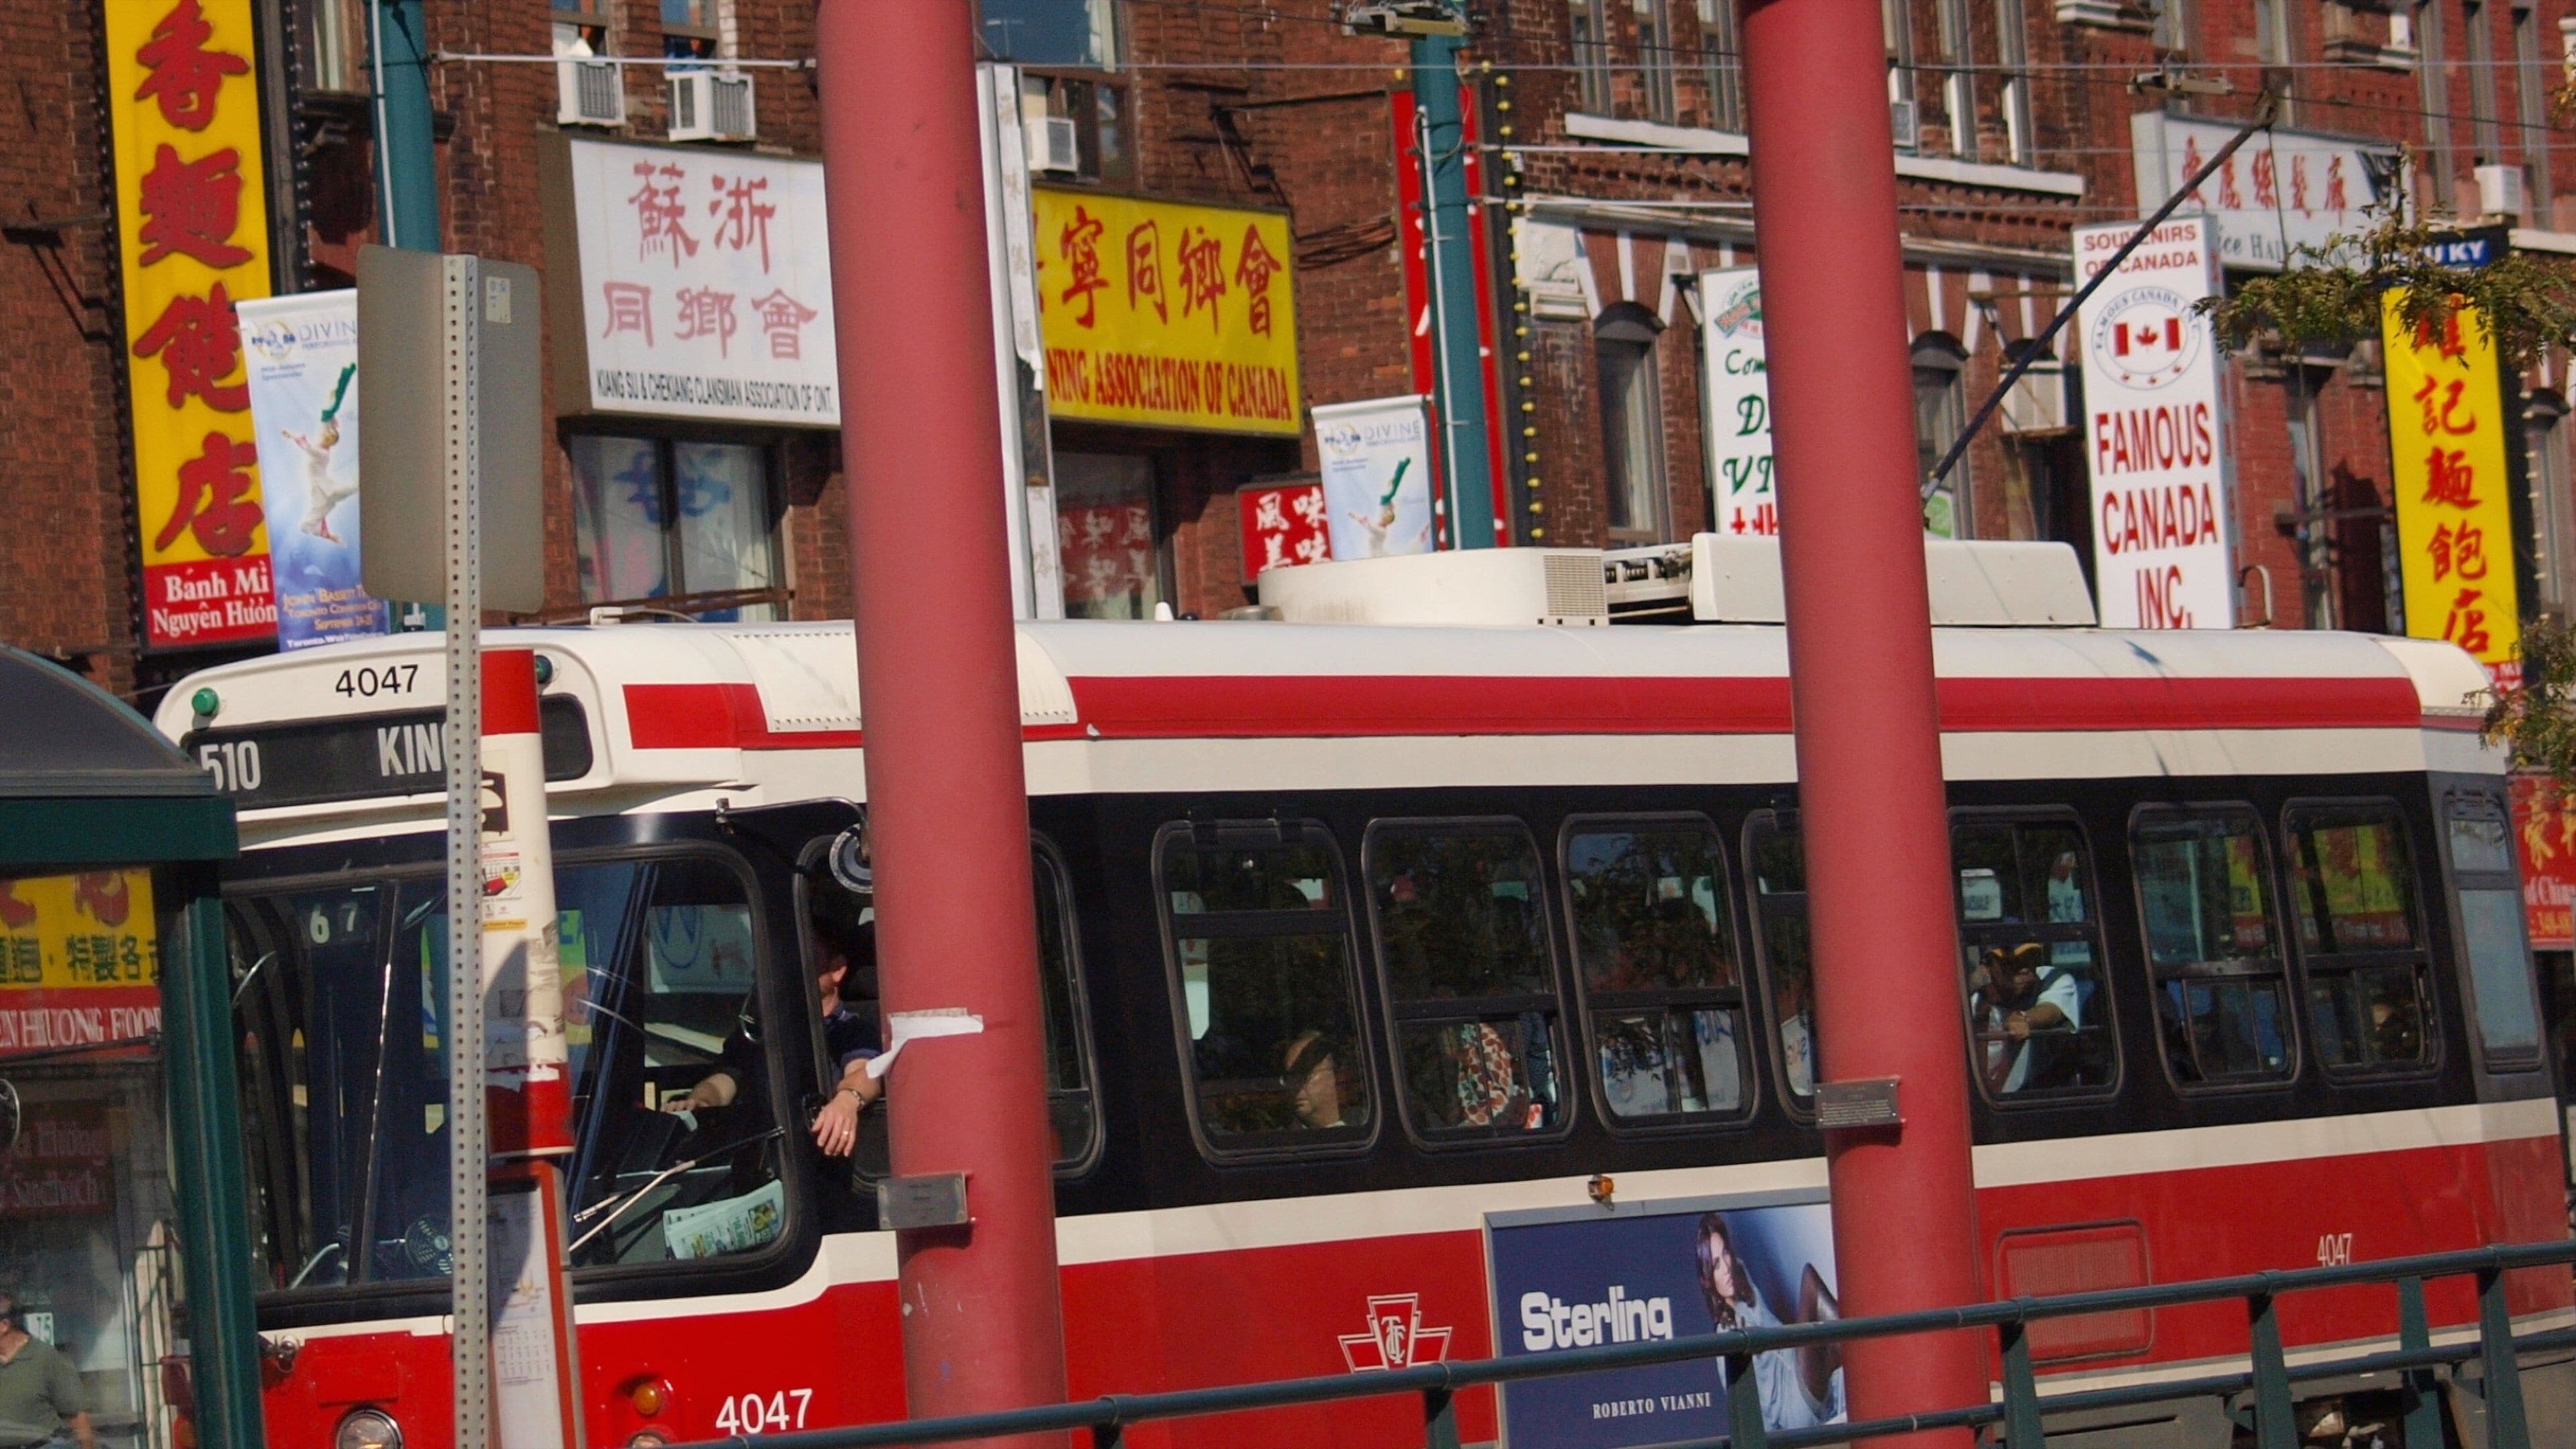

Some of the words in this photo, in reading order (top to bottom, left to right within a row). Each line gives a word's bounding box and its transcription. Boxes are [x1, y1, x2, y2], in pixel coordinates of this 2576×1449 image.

[1034, 205, 1283, 339] 寧同鄉會
[2118, 251, 2198, 273] CANADA
[602, 280, 818, 360] 同鄉會
[1094, 350, 1200, 414] ASSOCIATION
[1204, 360, 1223, 415] OF
[1226, 363, 1292, 421] CANADA
[2096, 402, 2211, 476] FAMOUS
[2102, 482, 2218, 555] CANADA
[2136, 565, 2192, 629] INC.
[335, 665, 419, 698] 4047
[200, 740, 261, 792] 510
[377, 722, 448, 777] KIN
[2316, 1232, 2353, 1267] 4047
[1520, 1285, 1674, 1352] Sterling
[715, 1389, 813, 1436] 4047
[1593, 1398, 1654, 1419] ROBERTO
[1660, 1391, 1711, 1411] VIANNI
